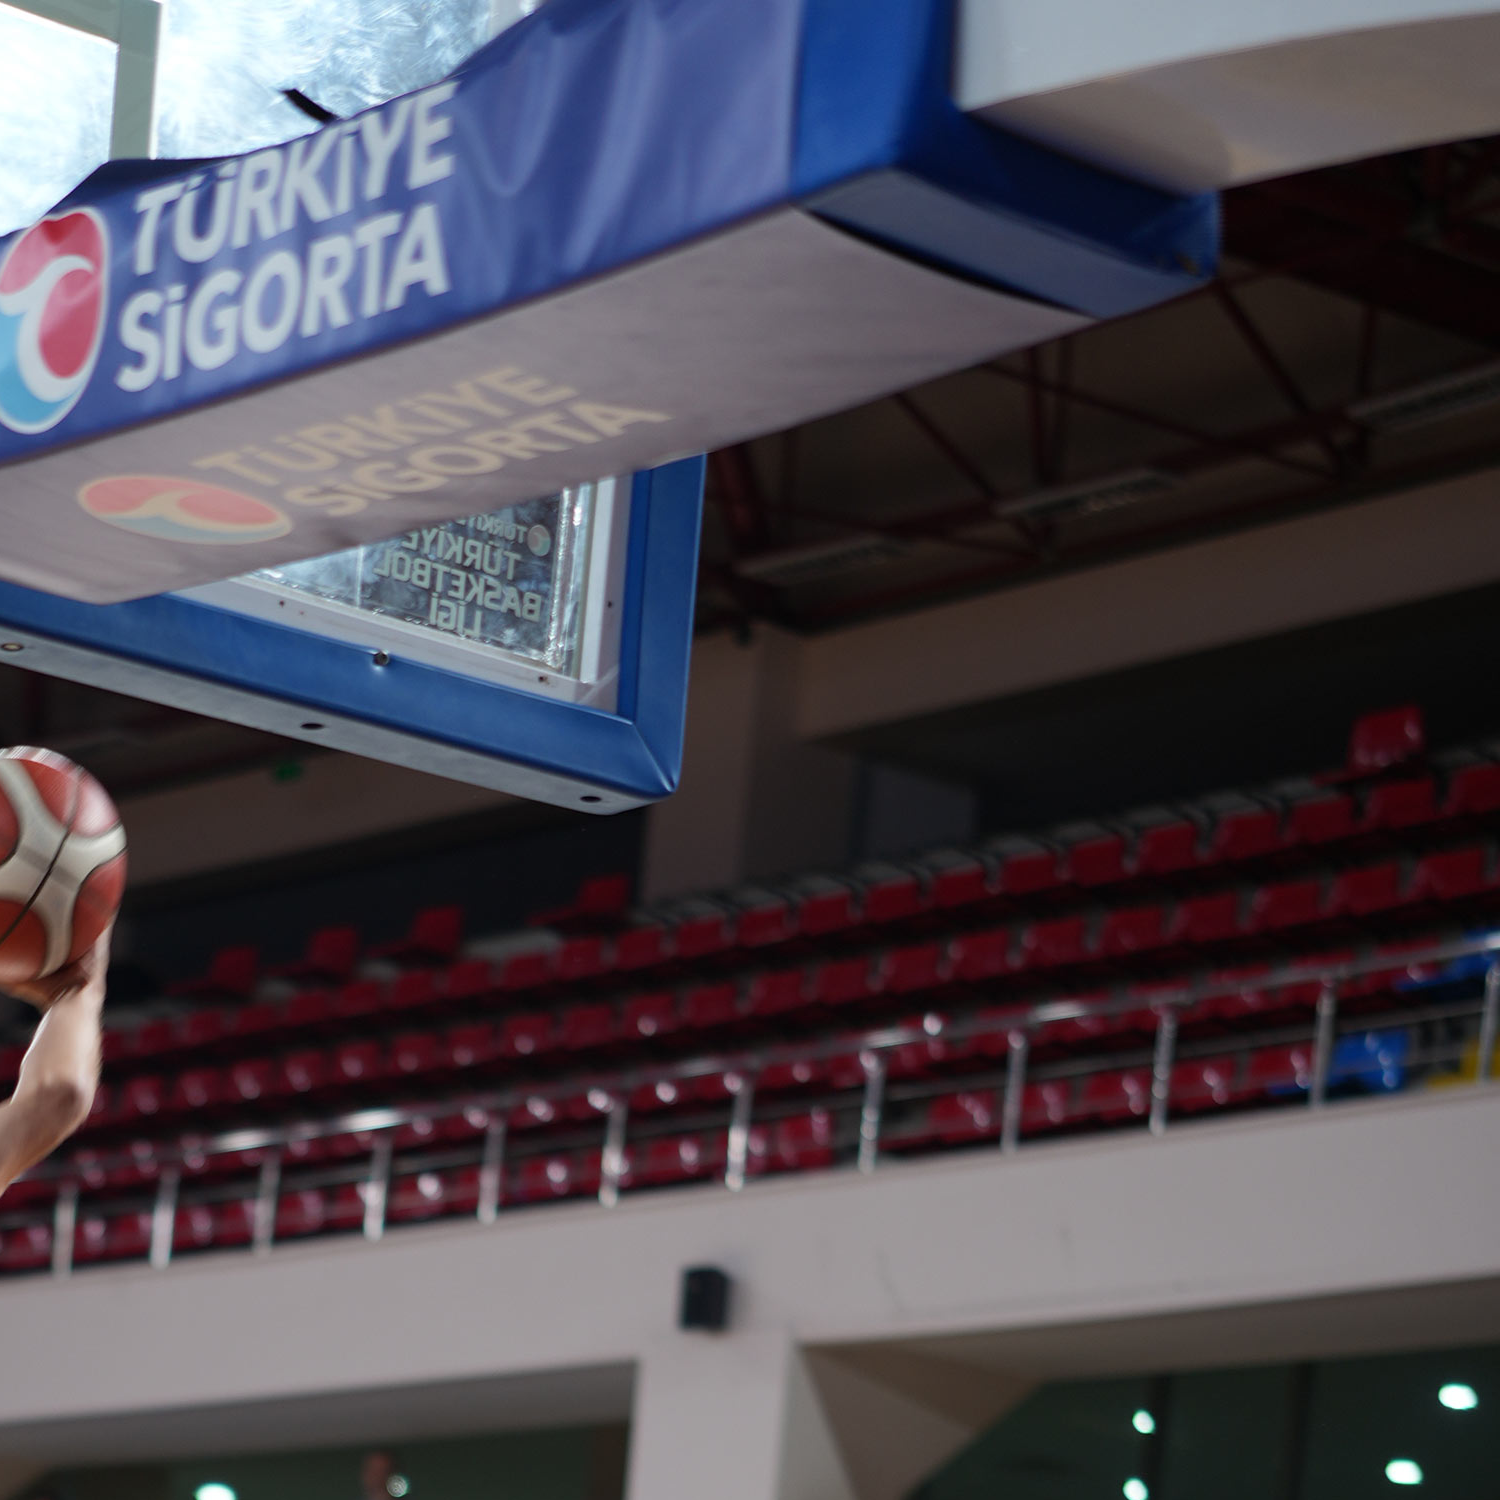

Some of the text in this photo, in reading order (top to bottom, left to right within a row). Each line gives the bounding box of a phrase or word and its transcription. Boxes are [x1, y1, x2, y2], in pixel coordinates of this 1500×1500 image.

[134, 80, 461, 277] TÜRKİYE
[115, 202, 451, 393] SİGORTA
[191, 366, 579, 487] TÜRKİYE
[284, 402, 673, 517] SİGORTA
